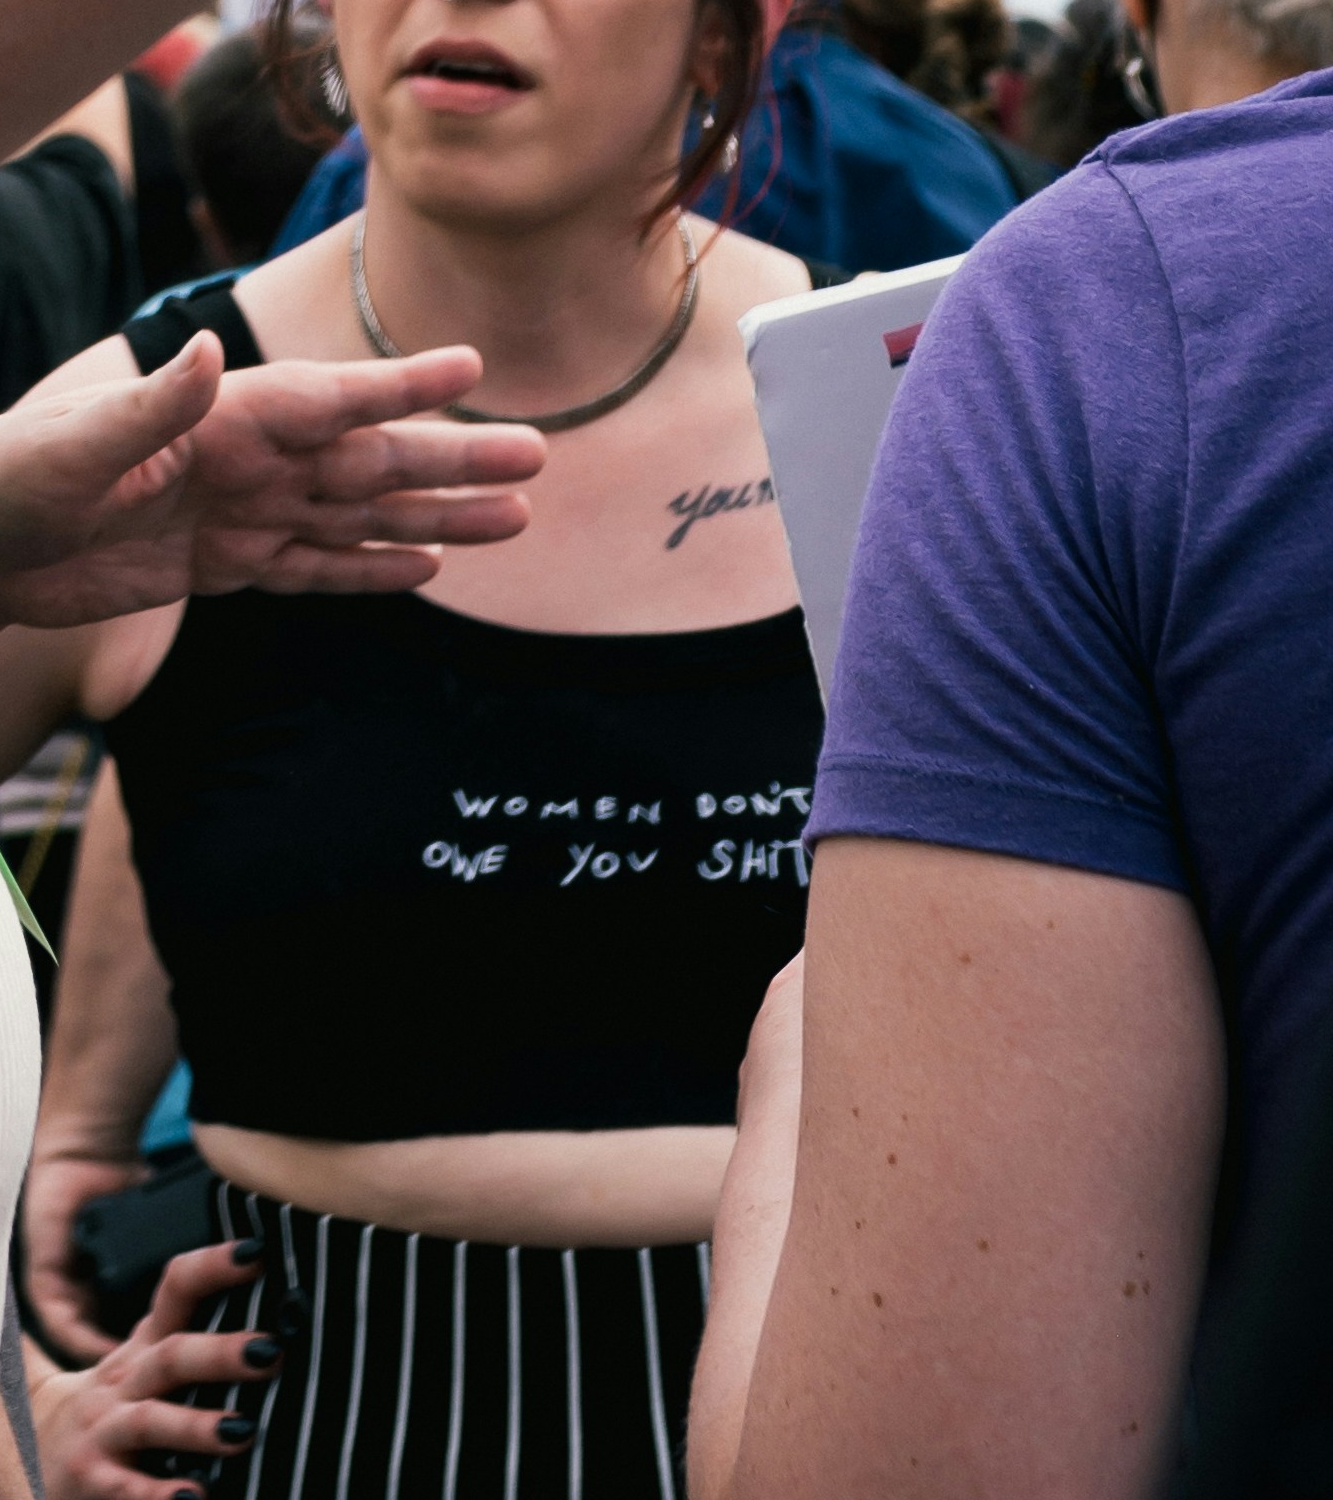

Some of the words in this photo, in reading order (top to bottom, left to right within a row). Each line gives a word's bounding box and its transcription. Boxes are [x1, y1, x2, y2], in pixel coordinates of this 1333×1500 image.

[452, 788, 662, 825] WOMEN
[696, 780, 811, 818] DON'T
[422, 840, 510, 883] OWE
[559, 841, 659, 888] YOU
[697, 839, 809, 888] SHIT
